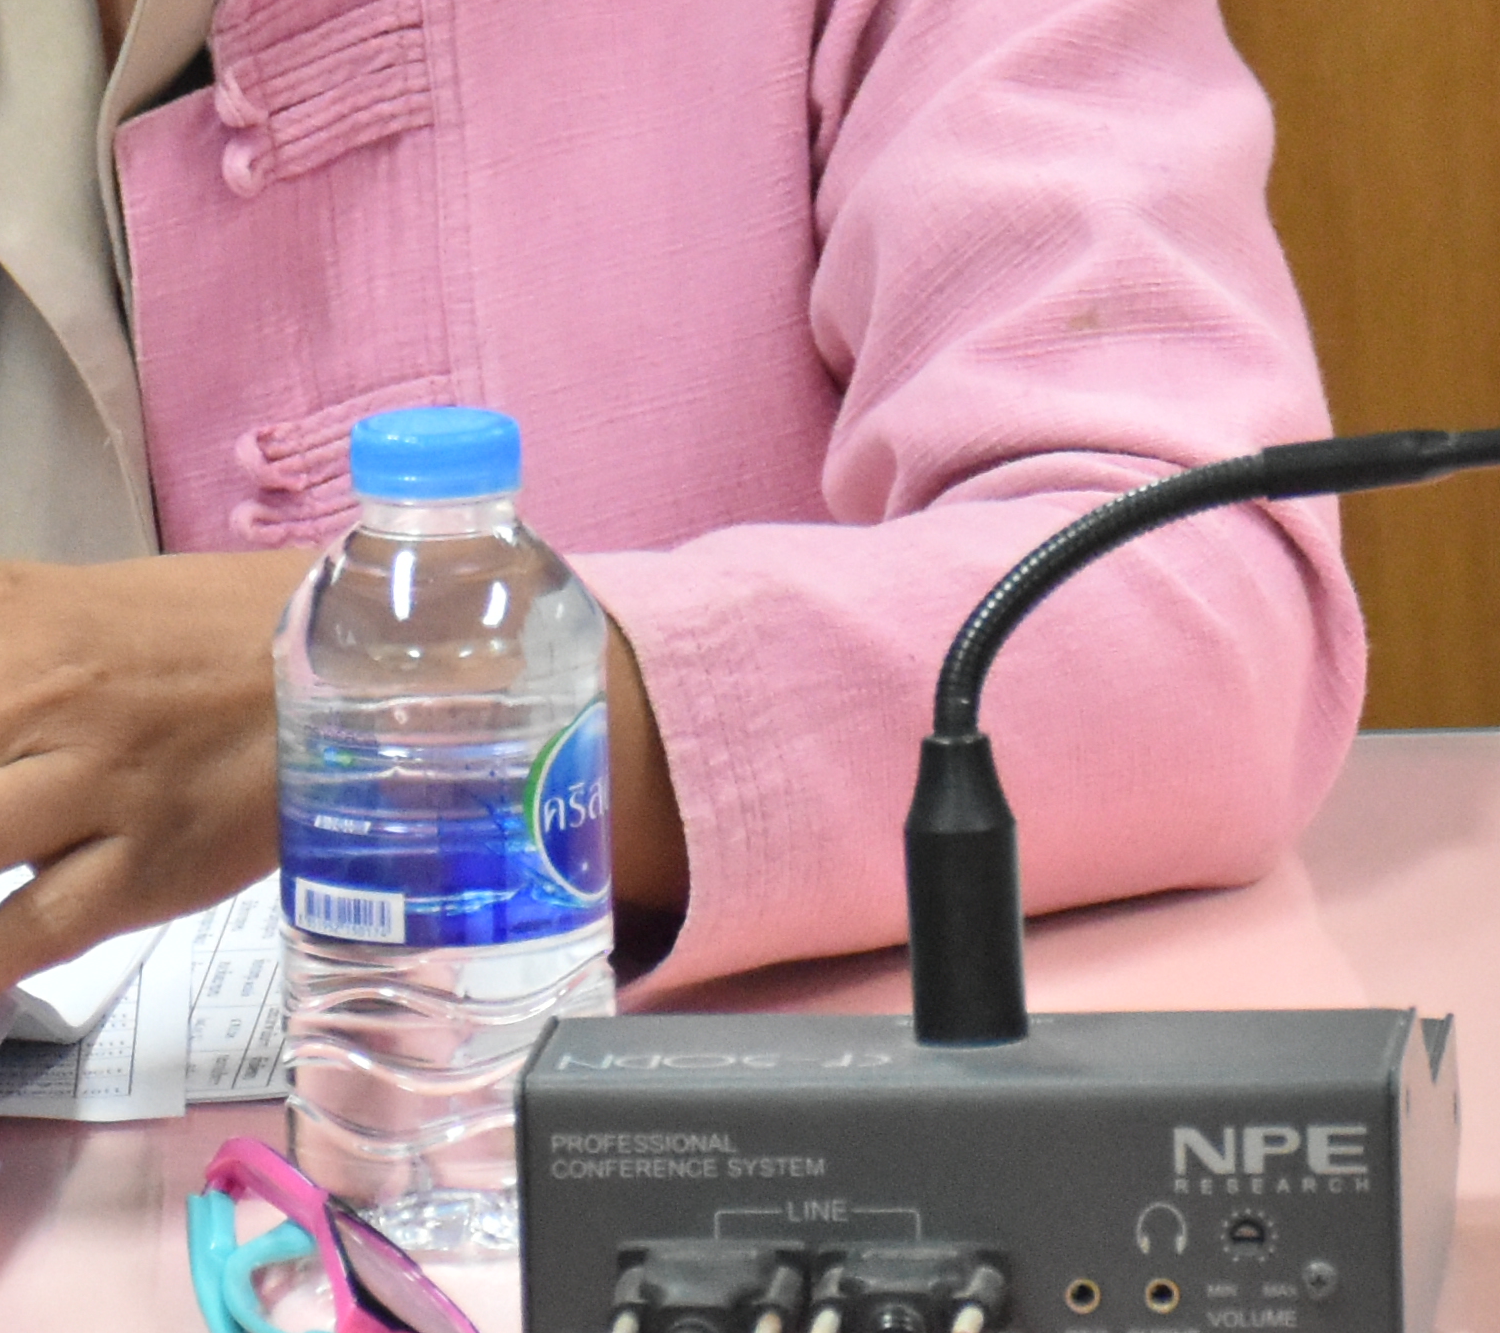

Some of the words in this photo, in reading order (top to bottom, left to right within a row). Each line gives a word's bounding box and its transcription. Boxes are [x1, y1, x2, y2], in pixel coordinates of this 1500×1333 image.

[544, 777, 606, 832] คริส
[550, 1133, 738, 1154] PROFESSIONAL
[1173, 1125, 1369, 1175] NPE
[550, 1159, 719, 1180] CONFERENCE
[727, 1158, 827, 1178] SYSTEM
[1174, 1177, 1371, 1195] RESEARCH
[785, 1199, 850, 1223] LINE
[1205, 1283, 1238, 1299] MIN
[1205, 1309, 1299, 1329] VOLUME
